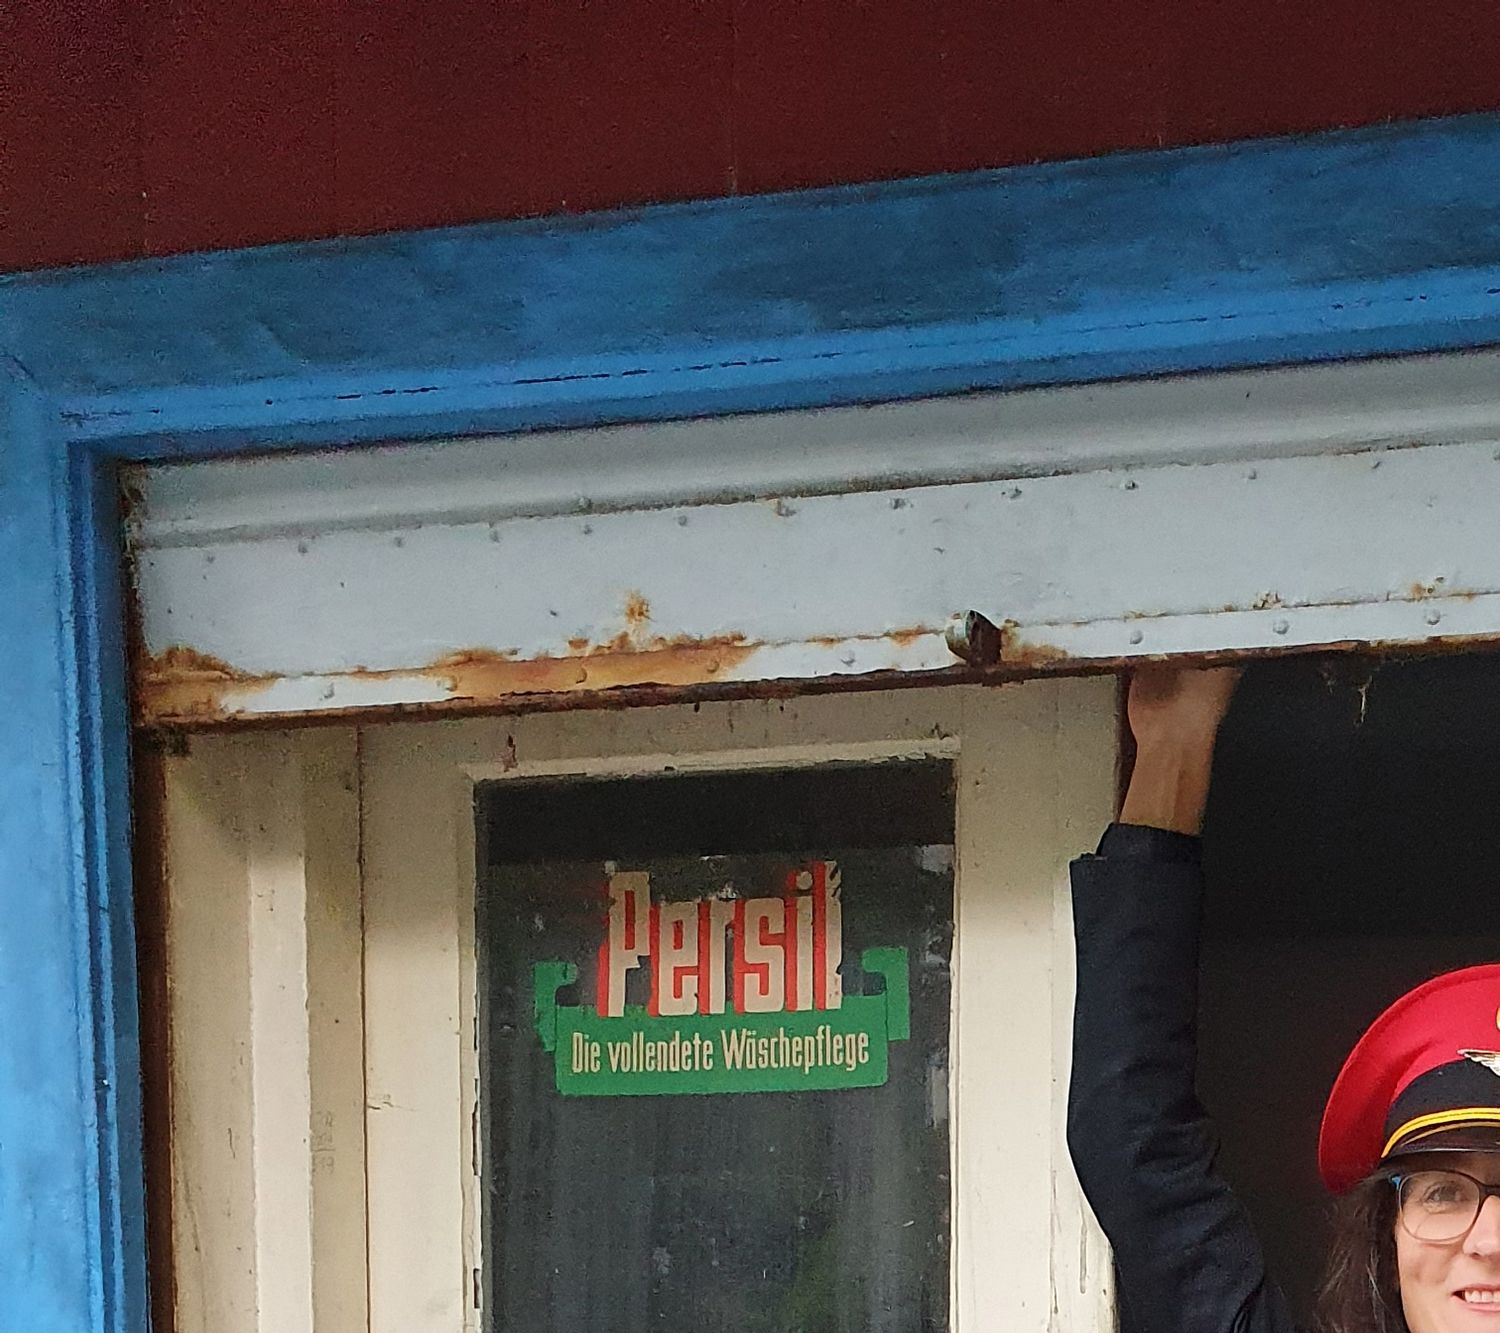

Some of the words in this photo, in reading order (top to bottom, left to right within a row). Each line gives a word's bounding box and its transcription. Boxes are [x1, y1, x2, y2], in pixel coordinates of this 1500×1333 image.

[600, 861, 843, 1018] Persil
[571, 1031, 601, 1074] Die
[608, 1030, 714, 1073] vollendete
[721, 1025, 870, 1075] Wäschepflege
